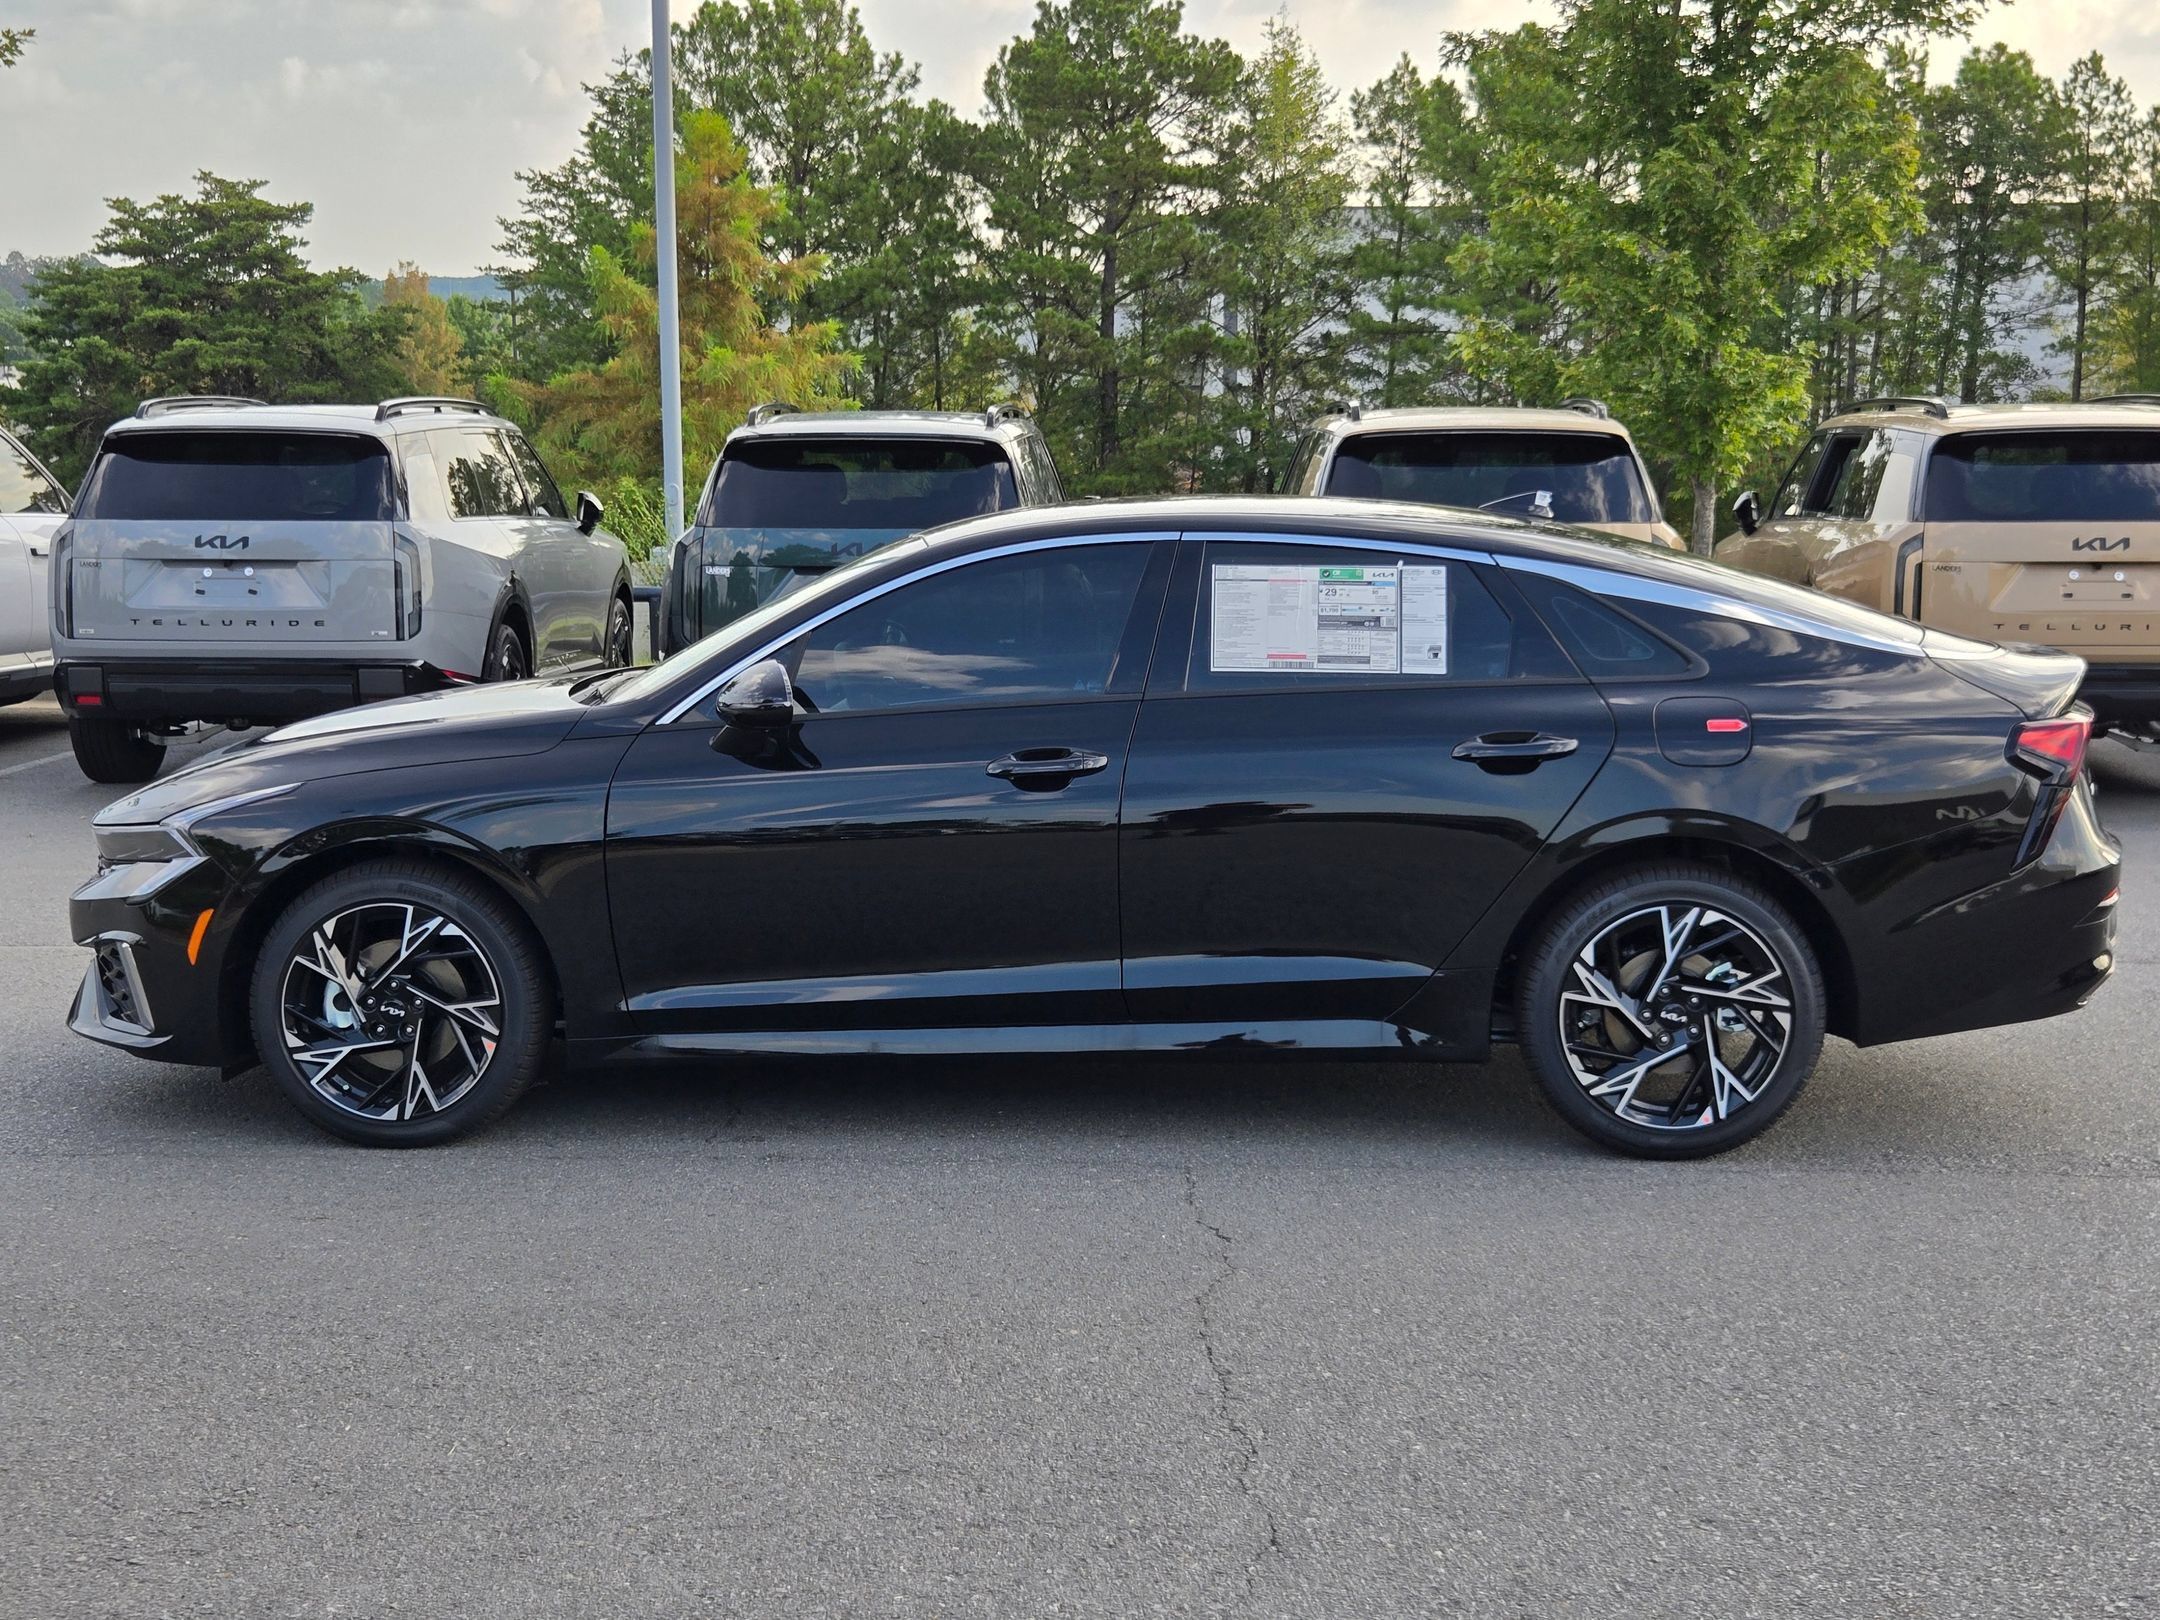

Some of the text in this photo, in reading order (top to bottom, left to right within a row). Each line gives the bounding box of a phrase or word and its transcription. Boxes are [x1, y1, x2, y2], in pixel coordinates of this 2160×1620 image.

[194, 535, 249, 549] KIA
[2072, 537, 2130, 551] KIA
[130, 618, 325, 627] TELLURIDE
